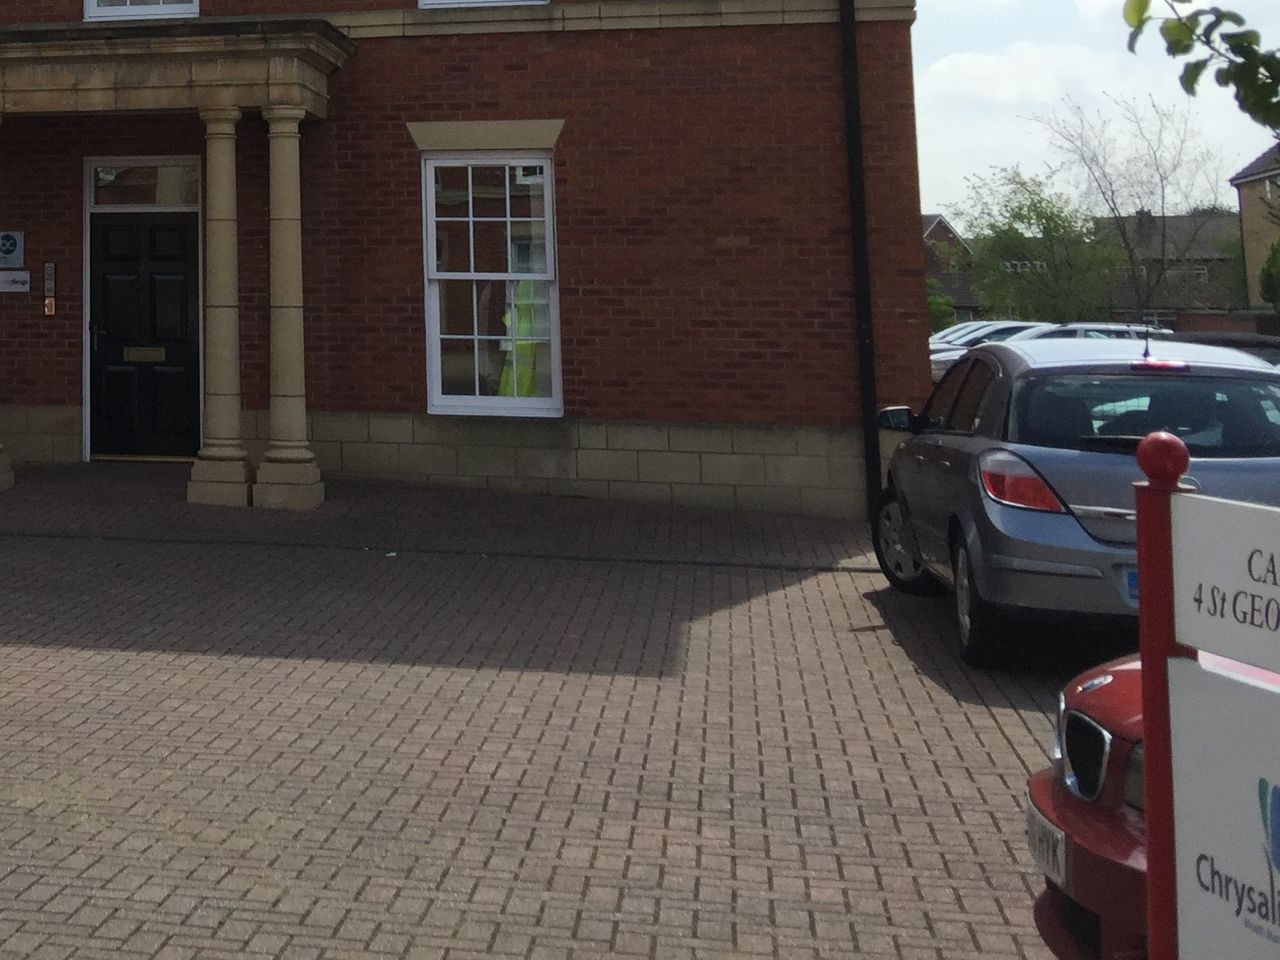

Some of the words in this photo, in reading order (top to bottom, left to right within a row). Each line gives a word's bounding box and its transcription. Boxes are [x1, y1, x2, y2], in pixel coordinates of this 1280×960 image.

[1247, 548, 1280, 586] CA
[1193, 583, 1203, 613] 4
[1207, 585, 1228, 618] St
[1232, 590, 1280, 632] GEO
